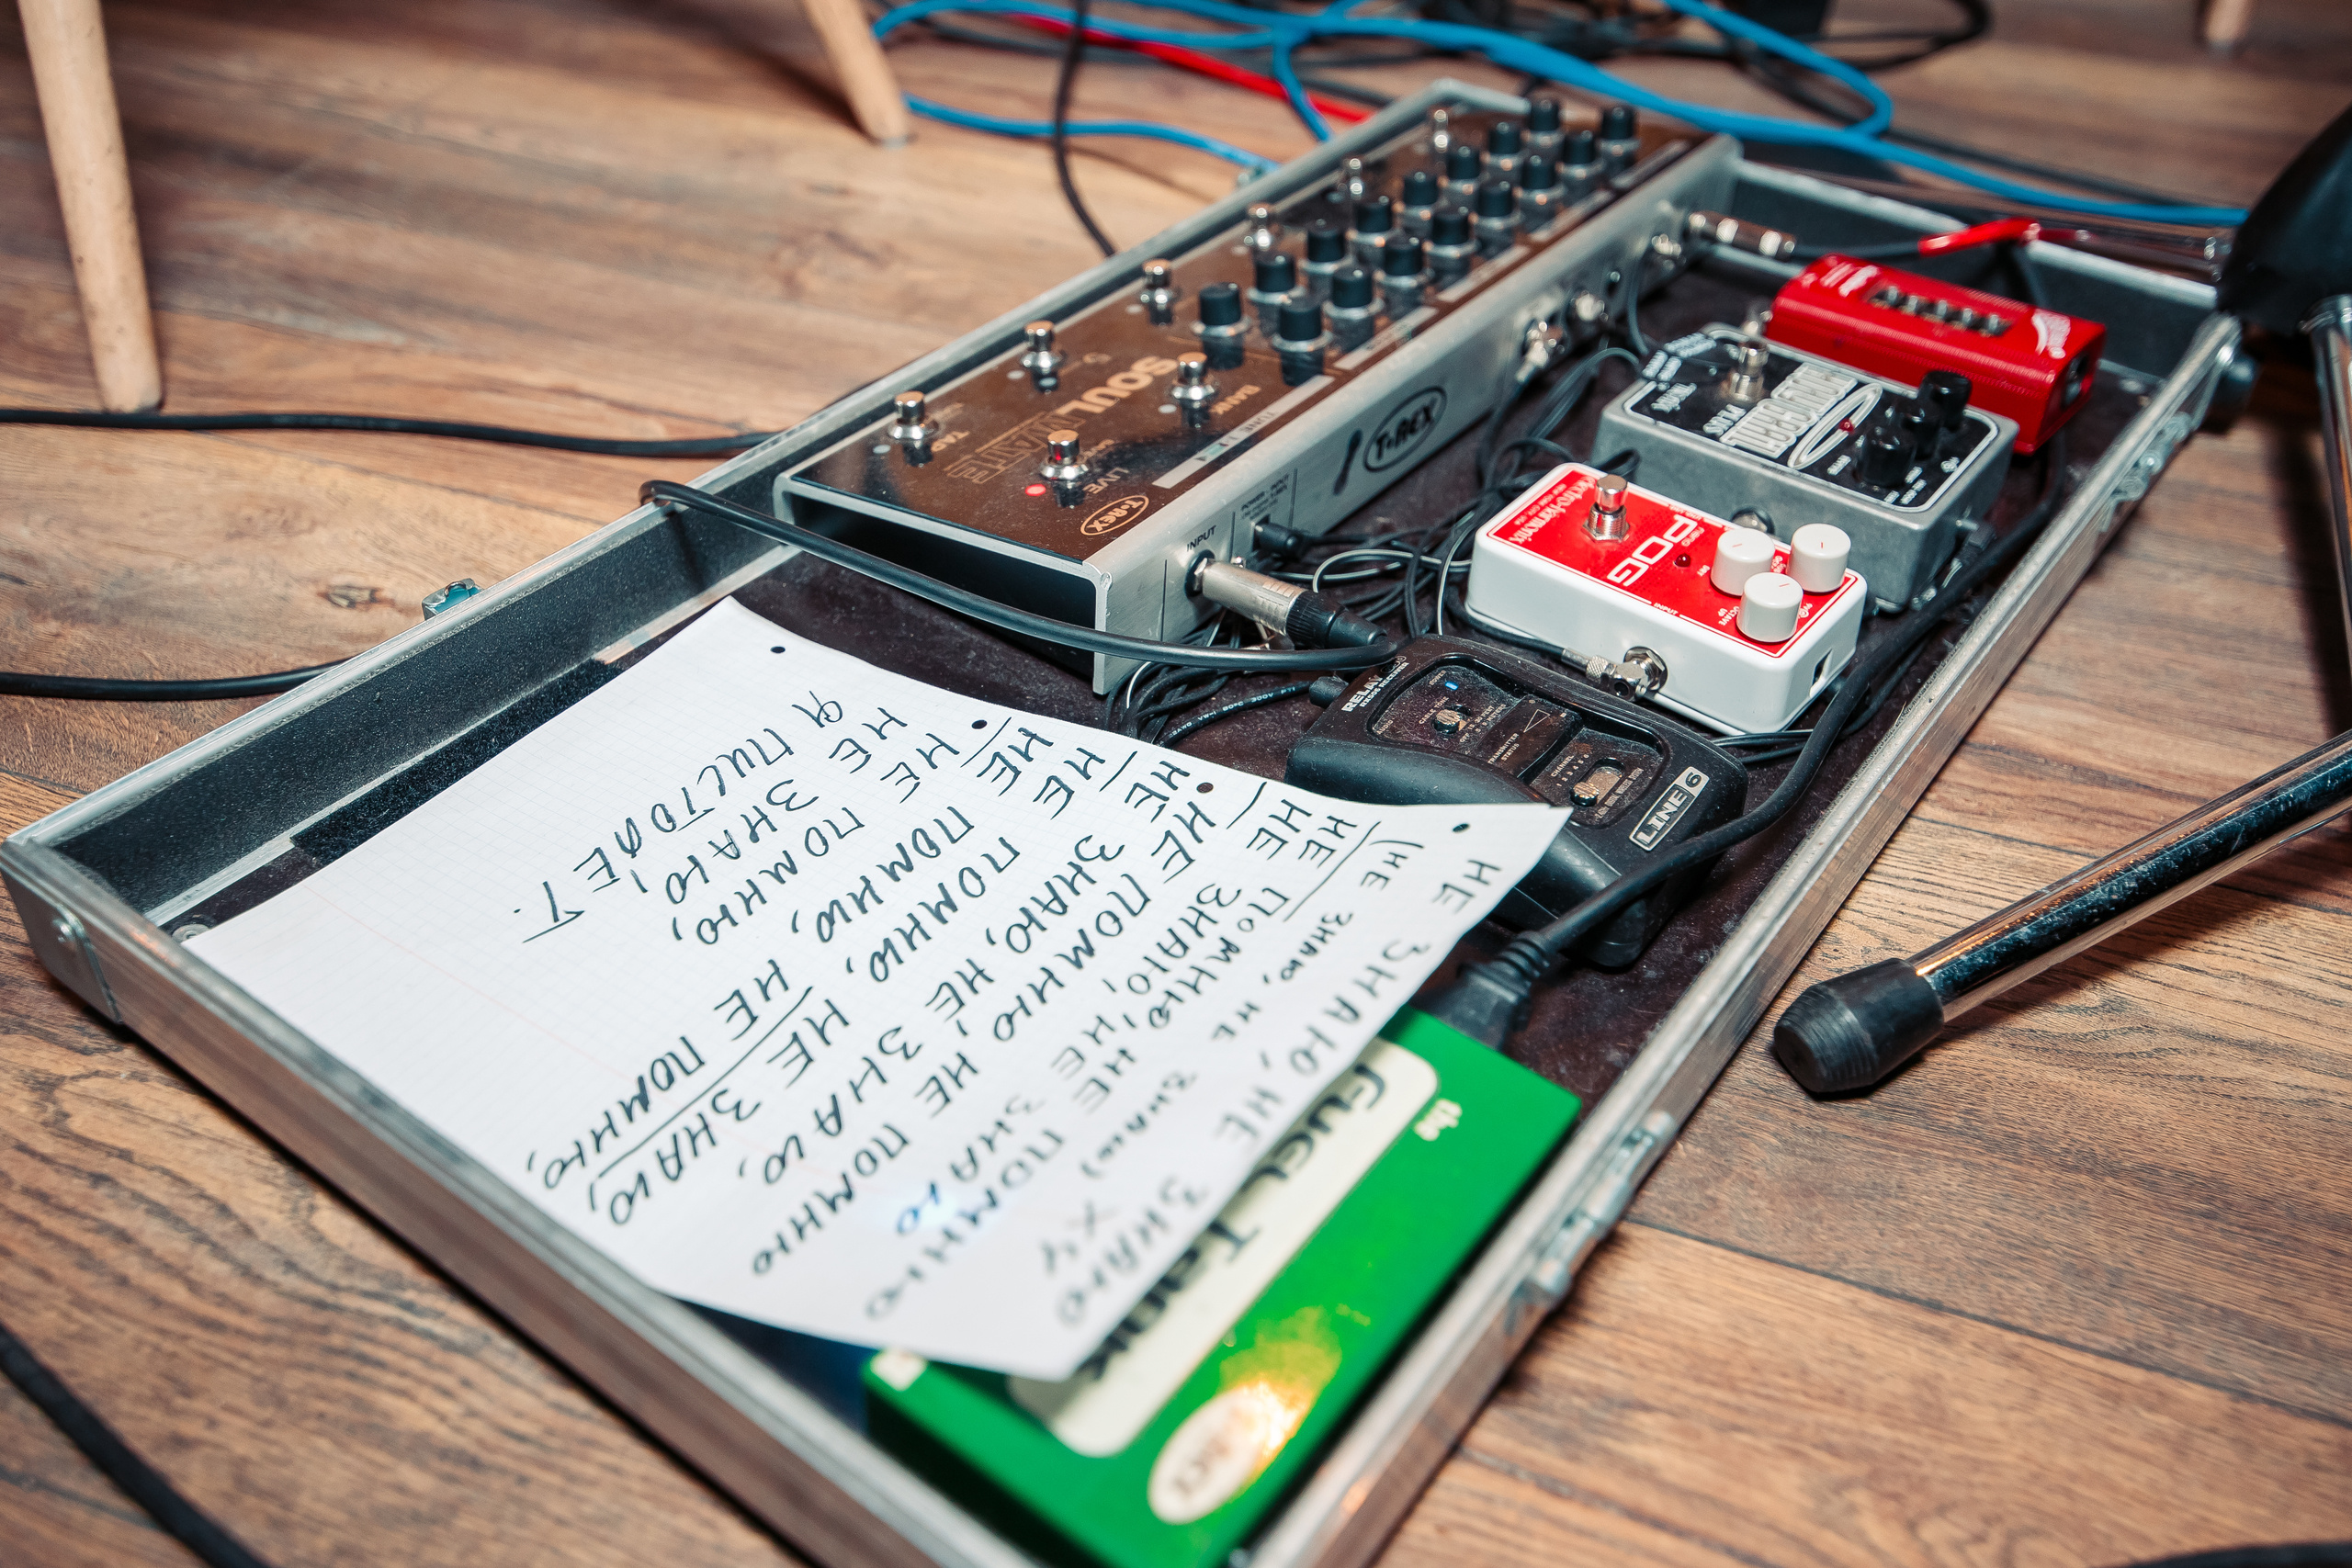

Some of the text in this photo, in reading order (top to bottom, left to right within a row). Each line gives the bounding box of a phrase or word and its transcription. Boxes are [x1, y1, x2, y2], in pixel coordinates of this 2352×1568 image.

[1083, 467, 1129, 494] LIVE
[1187, 525, 1216, 552] INPUT
[1607, 514, 1698, 586] POG
[1653, 602, 1679, 615] INPUT
[1718, 607, 1728, 617] UP
[1718, 605, 1740, 626] OCTAVE
[1341, 675, 1384, 712] RELAY
[1379, 661, 1409, 688] RECEIVER
[829, 707, 908, 773] НЕ
[1419, 694, 1450, 725] CABLE TONE
[1459, 732, 1470, 744] OFF
[1487, 732, 1520, 765] TRANSMITTER
[1500, 742, 1520, 761] STATUS
[1550, 754, 1575, 778] CHANNEL
[1033, 748, 1105, 819] НЕ
[1125, 761, 1189, 823] НЕ
[1636, 771, 1703, 845] LINE 6
[673, 733, 960, 945] НЕ ПОМНЮ,
[1151, 801, 1217, 883] НЕ
[1246, 799, 1312, 860] НЕ
[1298, 815, 1360, 870] НЕ
[846, 837, 1020, 982] ПОМНЮ,
[986, 835, 1125, 953] ЗНАЮ,
[1430, 860, 1501, 914] НЕ
[527, 728, 1054, 1189] НЕ ПОМНЮ, НЕ ПОМНЮ,
[925, 958, 993, 1021] НЕ
[767, 999, 849, 1085] НЕ
[1050, 1015, 1117, 1081] НЕ
[914, 1051, 979, 1118] НЕ
[1073, 1048, 1136, 1113] НЕ
[1413, 1099, 1462, 1141] the
[753, 1124, 909, 1273] ПОМНЮ
